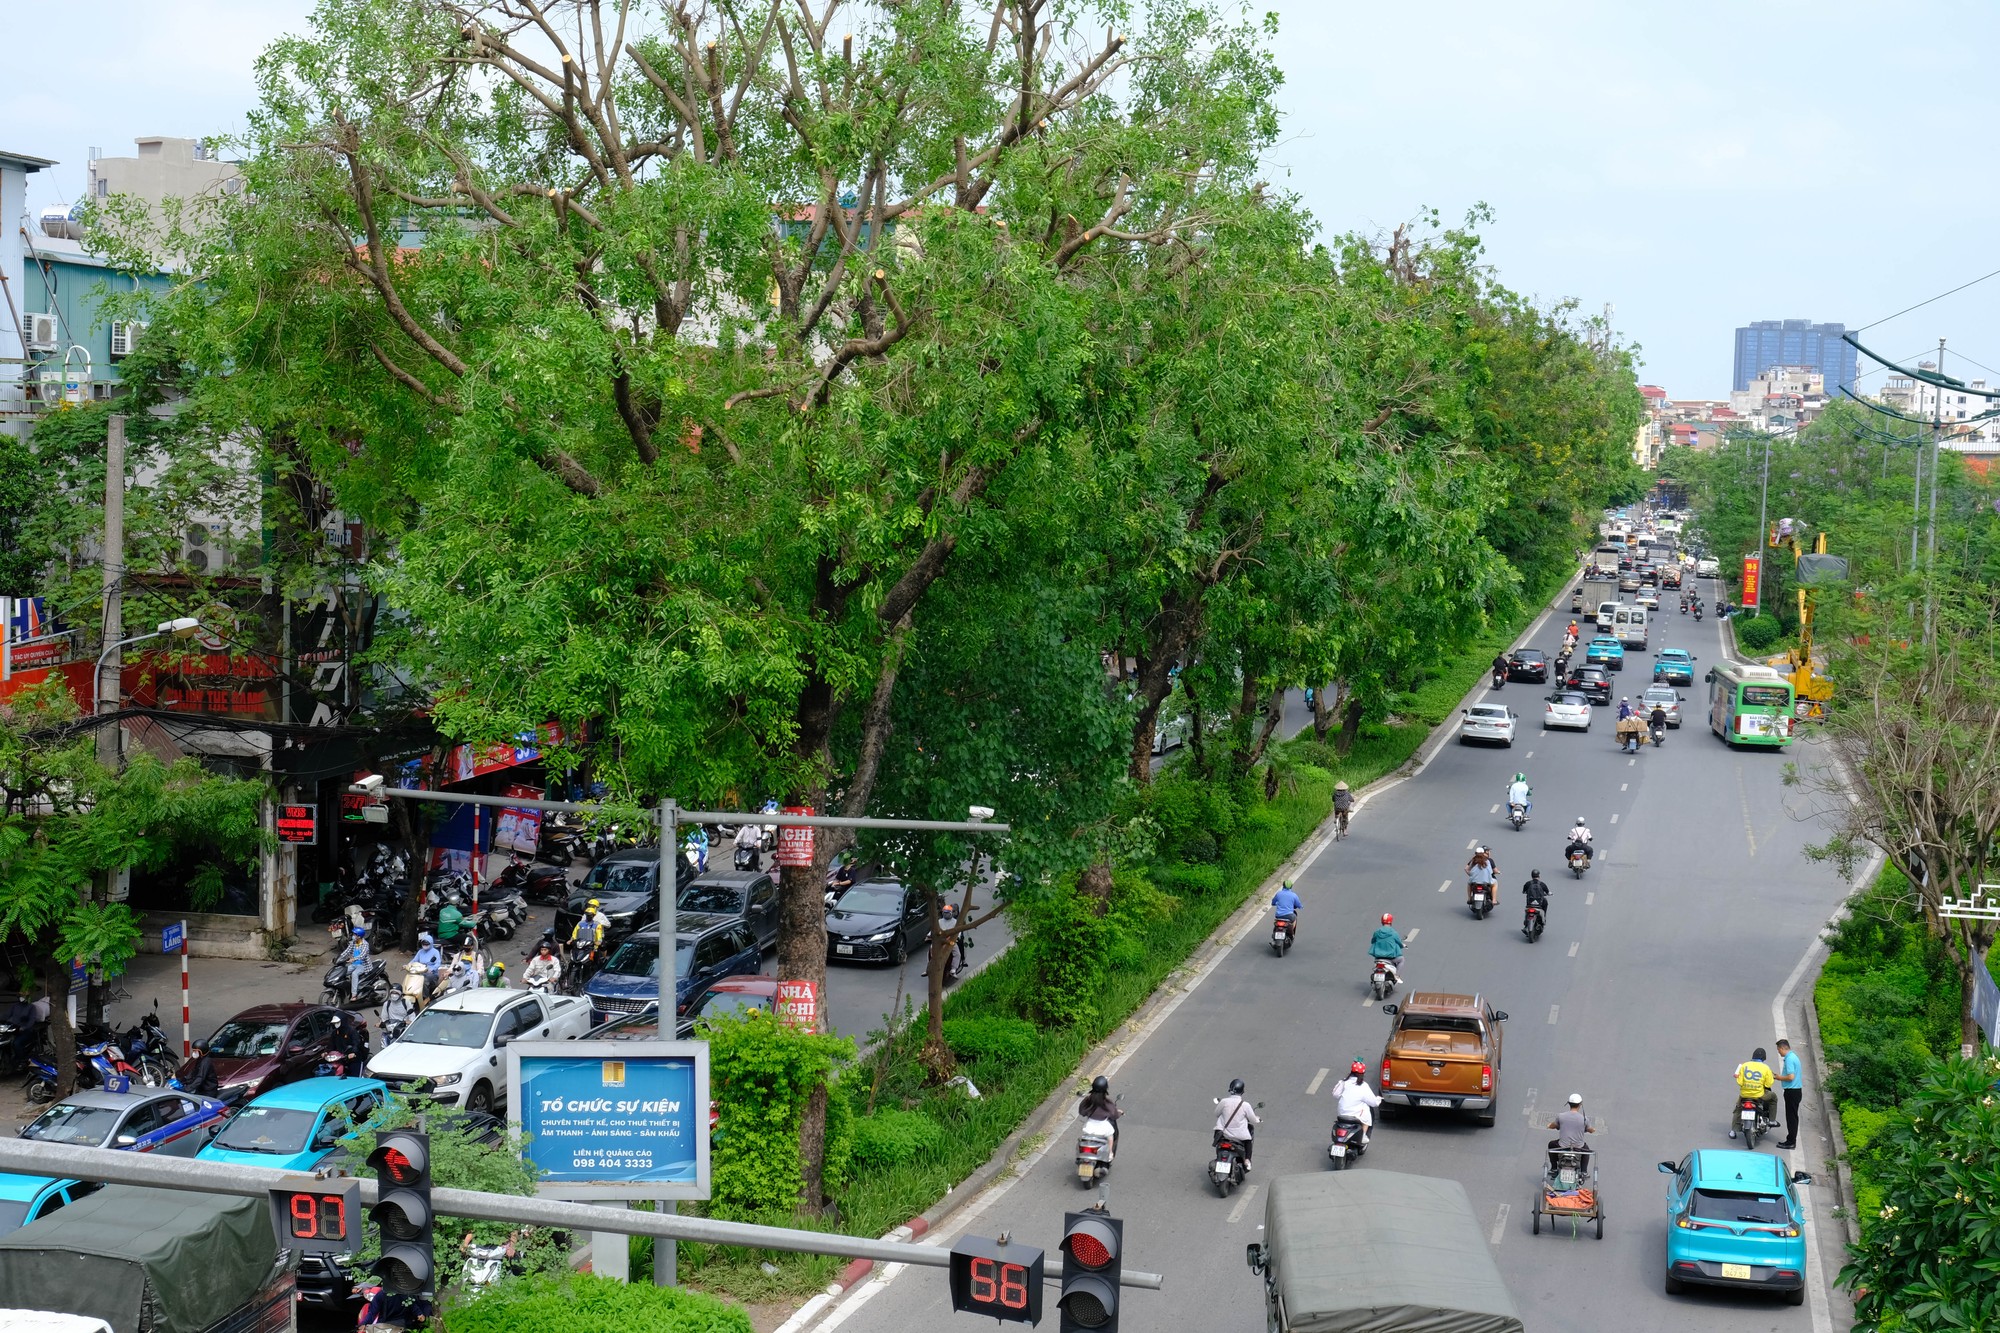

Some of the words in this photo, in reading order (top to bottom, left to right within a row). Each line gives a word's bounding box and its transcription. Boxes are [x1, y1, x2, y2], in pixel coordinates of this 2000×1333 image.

[207, 691, 228, 712] THE
[780, 983, 813, 998] NHÀ
[1744, 1066, 1762, 1081] be
[542, 1096, 563, 1112] TỔ
[568, 1098, 612, 1112] CHỨC
[616, 1099, 640, 1115] SỰ
[642, 1098, 680, 1115] KIỆN
[541, 1118, 571, 1126] CHUYÊN
[573, 1118, 594, 1126] THIẾT
[628, 1119, 647, 1127] THUÊ
[649, 1119, 670, 1127] THIẾT
[541, 1128, 554, 1136] ÂM
[591, 1128, 608, 1136] ÁNH
[658, 1128, 680, 1137] KHẤU
[573, 1148, 591, 1156] LIÊN
[594, 1149, 604, 1158] HỆ
[606, 1149, 634, 1157] QUẢNG
[573, 1159, 595, 1168] 098
[599, 1159, 621, 1168] 404
[625, 1159, 652, 1168] 3333
[290, 1194, 346, 1239] 97
[970, 1257, 1027, 1309] 56
